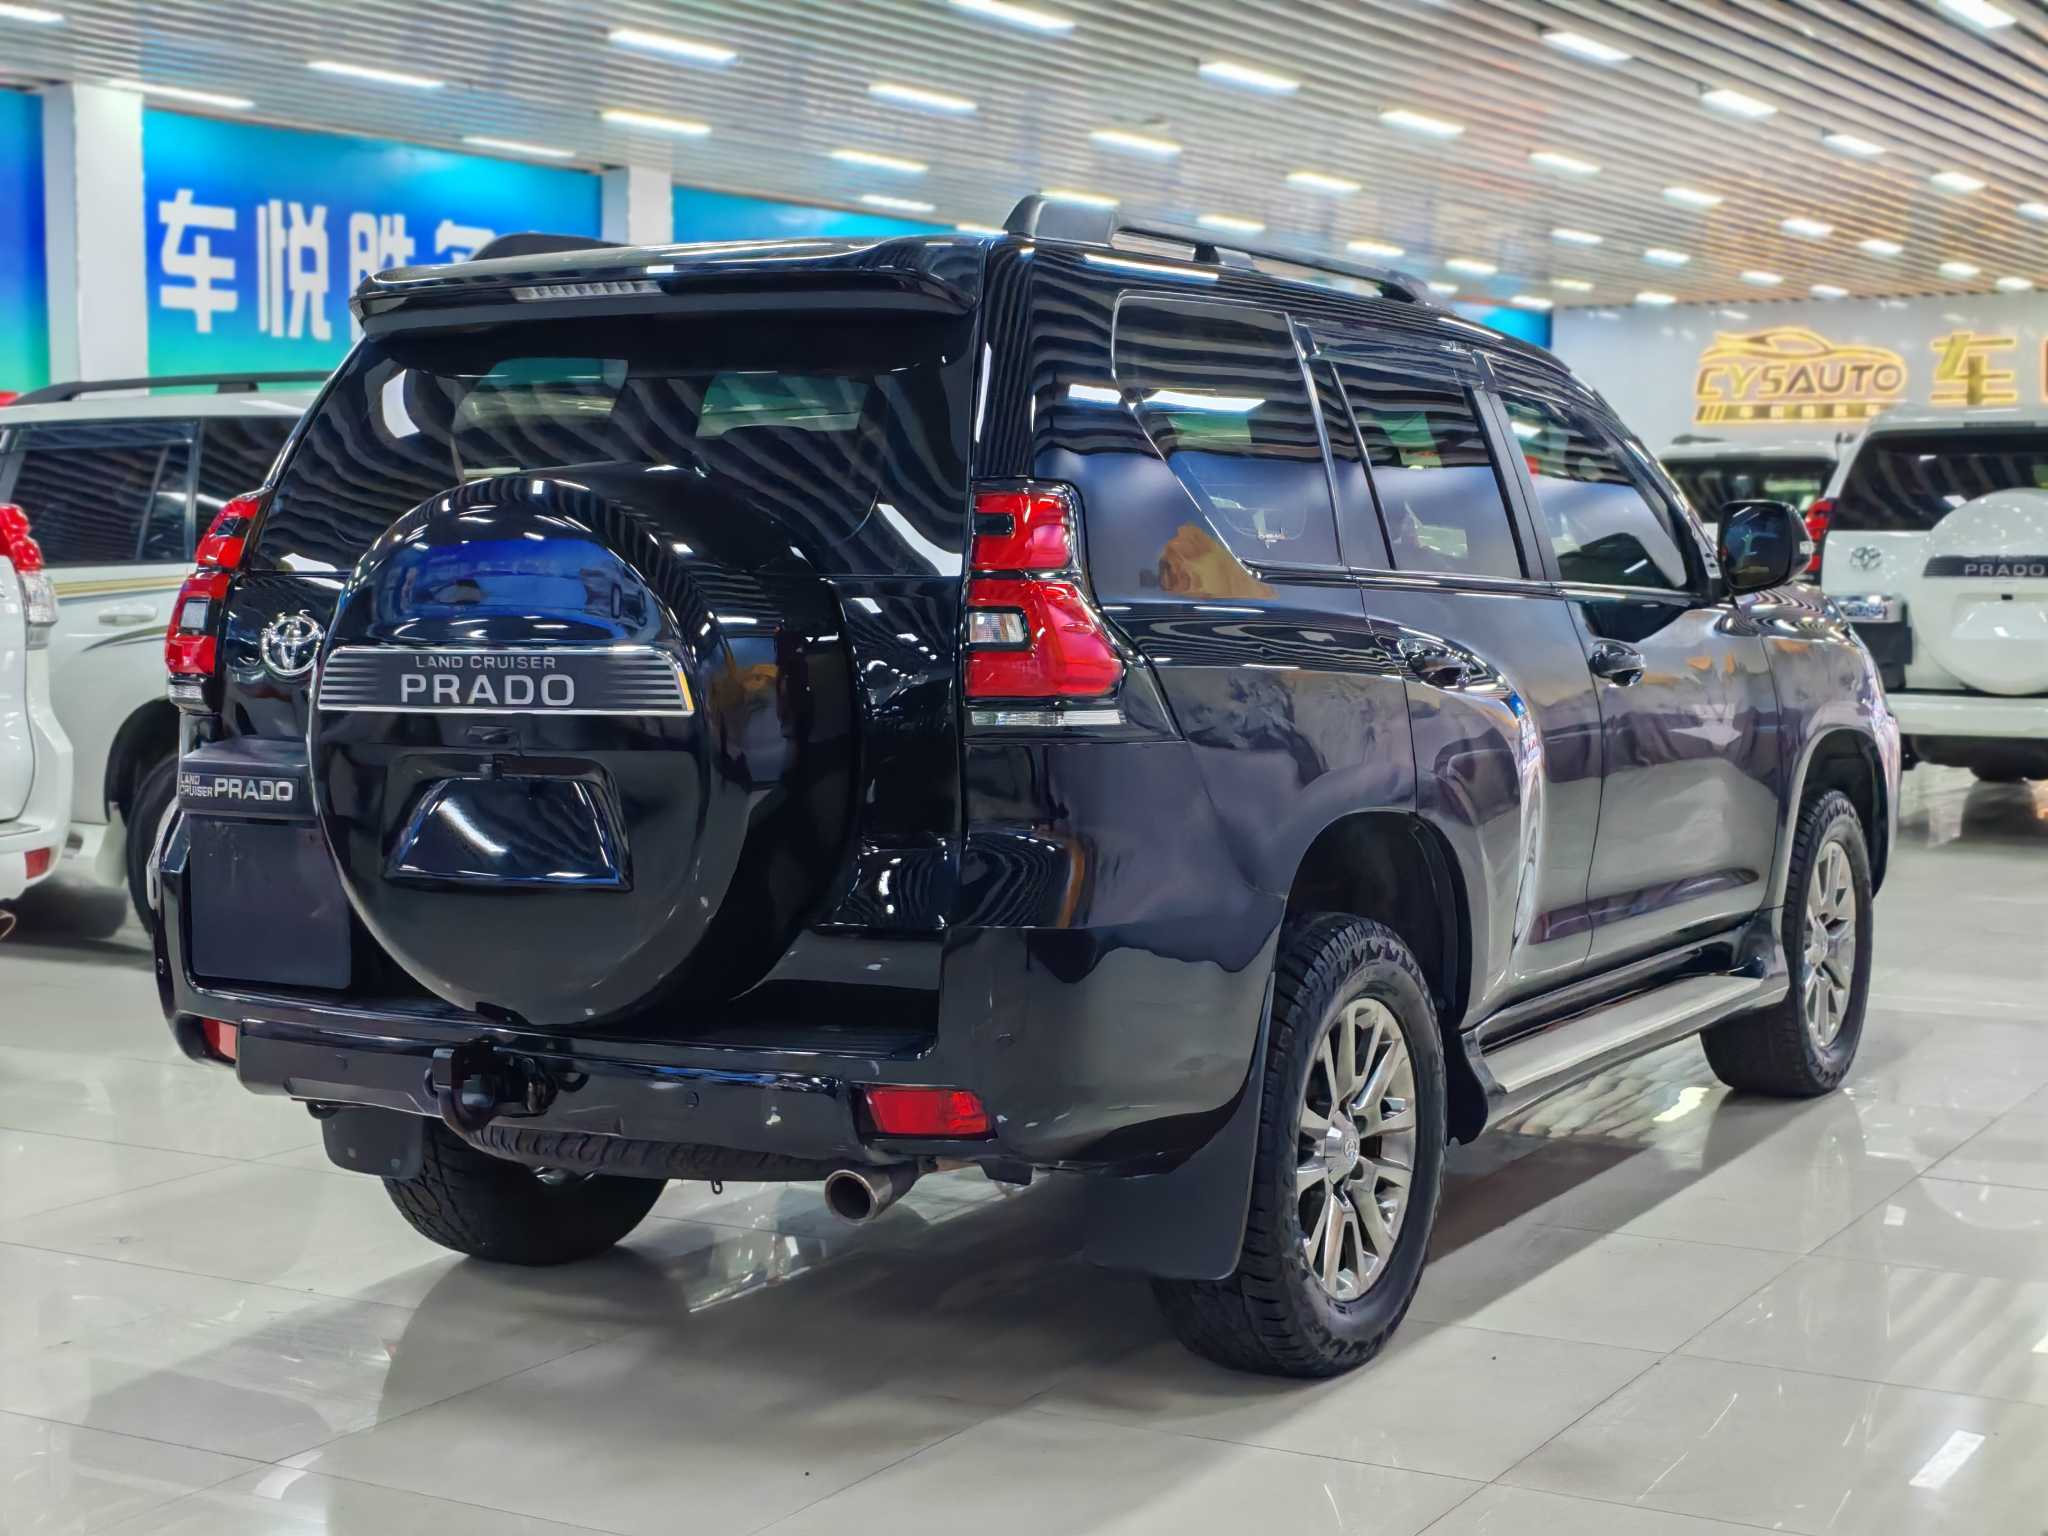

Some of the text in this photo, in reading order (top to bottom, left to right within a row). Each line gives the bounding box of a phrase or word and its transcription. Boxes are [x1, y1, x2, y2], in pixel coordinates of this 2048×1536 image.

[1929, 331, 2048, 407] 车
[1696, 363, 1905, 398] CYSAUTO
[1964, 563, 2046, 576] PRADO
[415, 655, 556, 669] LAND CRUISER
[400, 673, 575, 707] PRADO
[180, 772, 200, 785] LAND
[180, 784, 213, 797] CRUISER
[214, 778, 293, 801] PRADO
